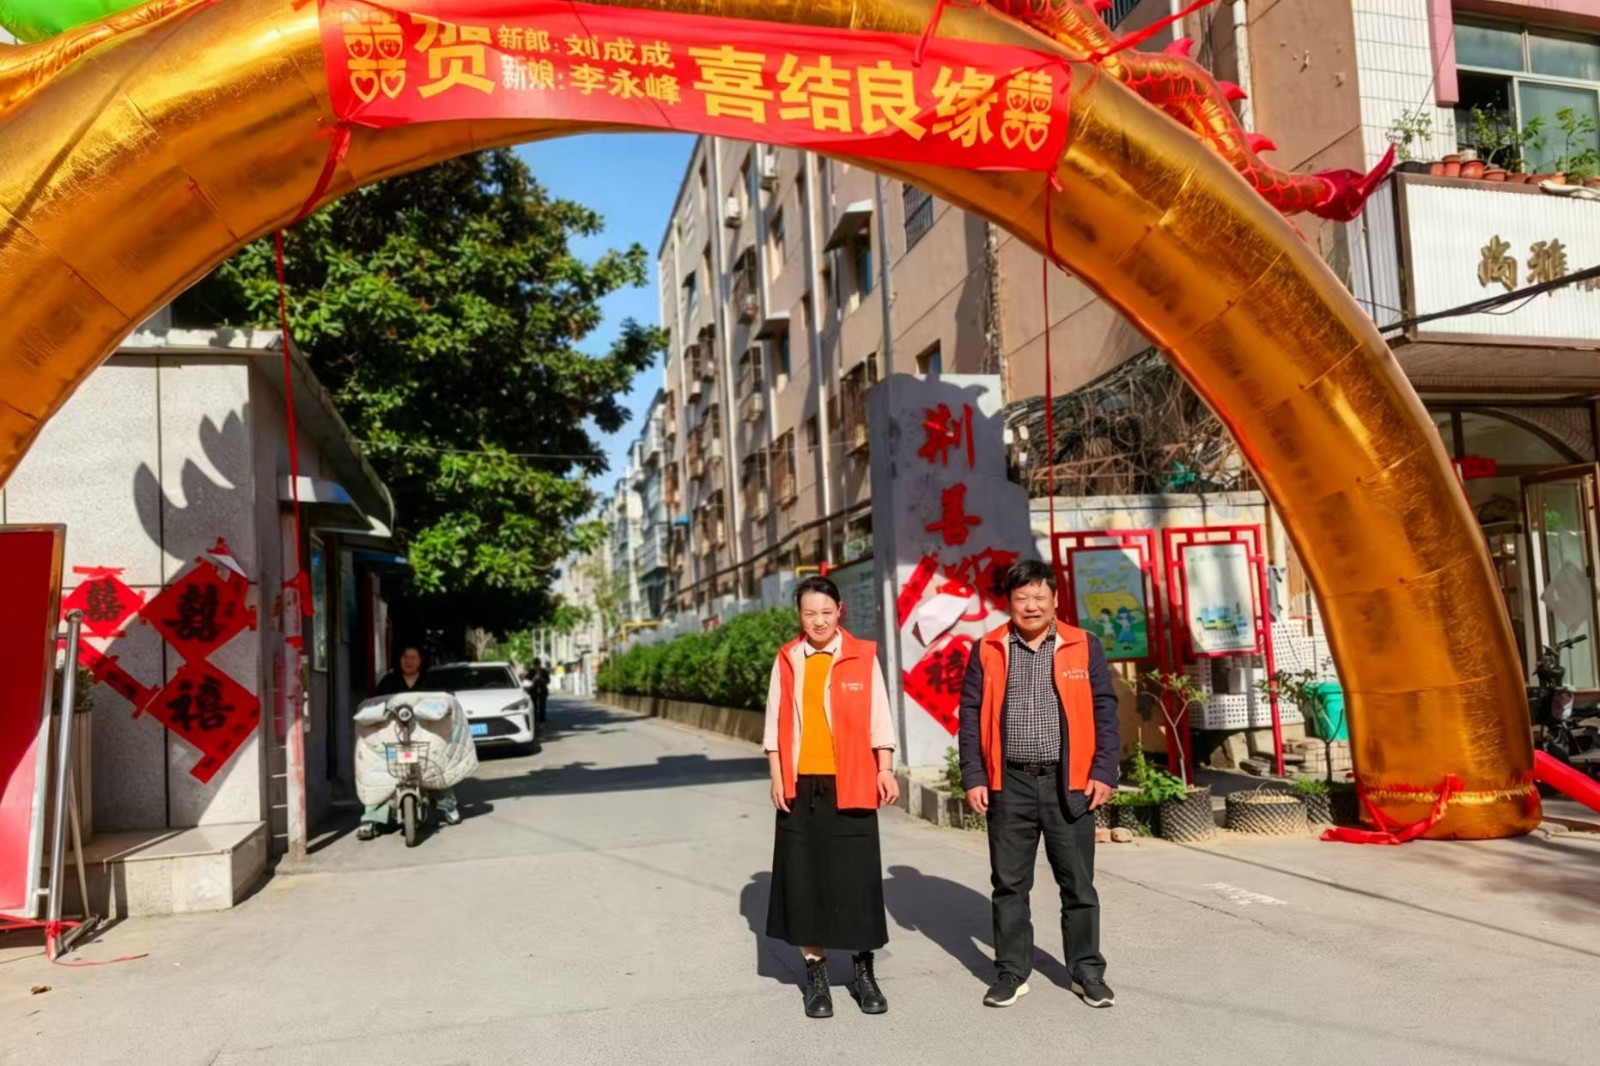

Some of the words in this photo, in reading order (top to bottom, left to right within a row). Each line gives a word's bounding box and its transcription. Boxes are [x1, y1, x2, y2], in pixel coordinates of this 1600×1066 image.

[409, 12, 496, 99] 贺
[688, 45, 998, 148] 喜结良缘
